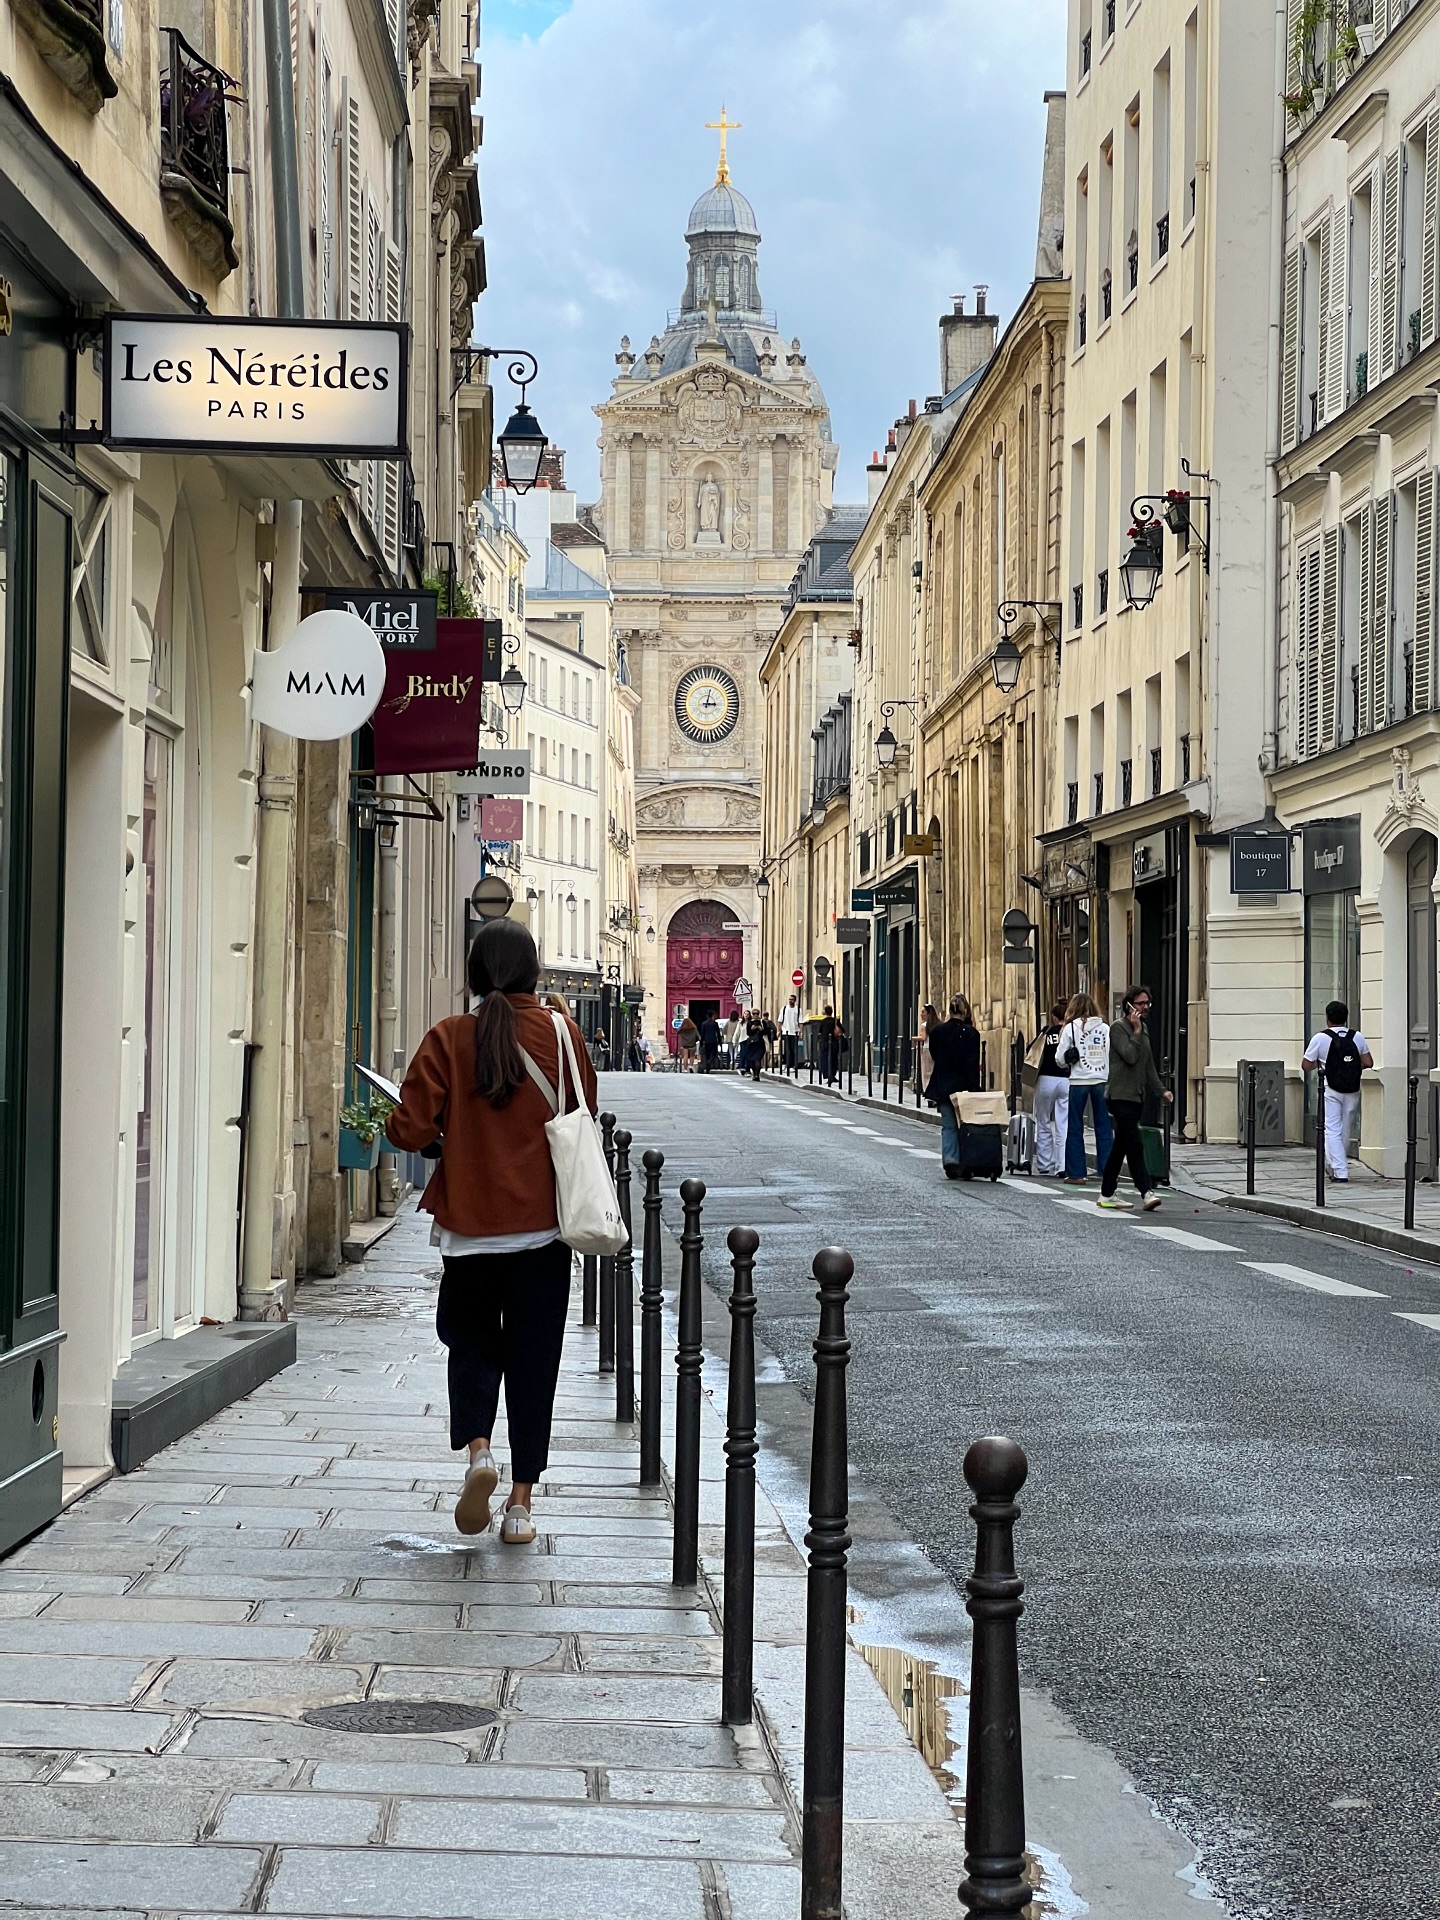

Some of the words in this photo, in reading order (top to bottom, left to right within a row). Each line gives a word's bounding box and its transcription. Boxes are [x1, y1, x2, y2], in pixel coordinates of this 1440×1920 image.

[120, 343, 193, 384] Les
[206, 347, 390, 391] Néréides
[207, 399, 306, 421] PARIS
[342, 600, 420, 631] Miel
[456, 765, 525, 778] SANDRO
[1240, 851, 1282, 862] boutique
[1255, 868, 1267, 877] 17
